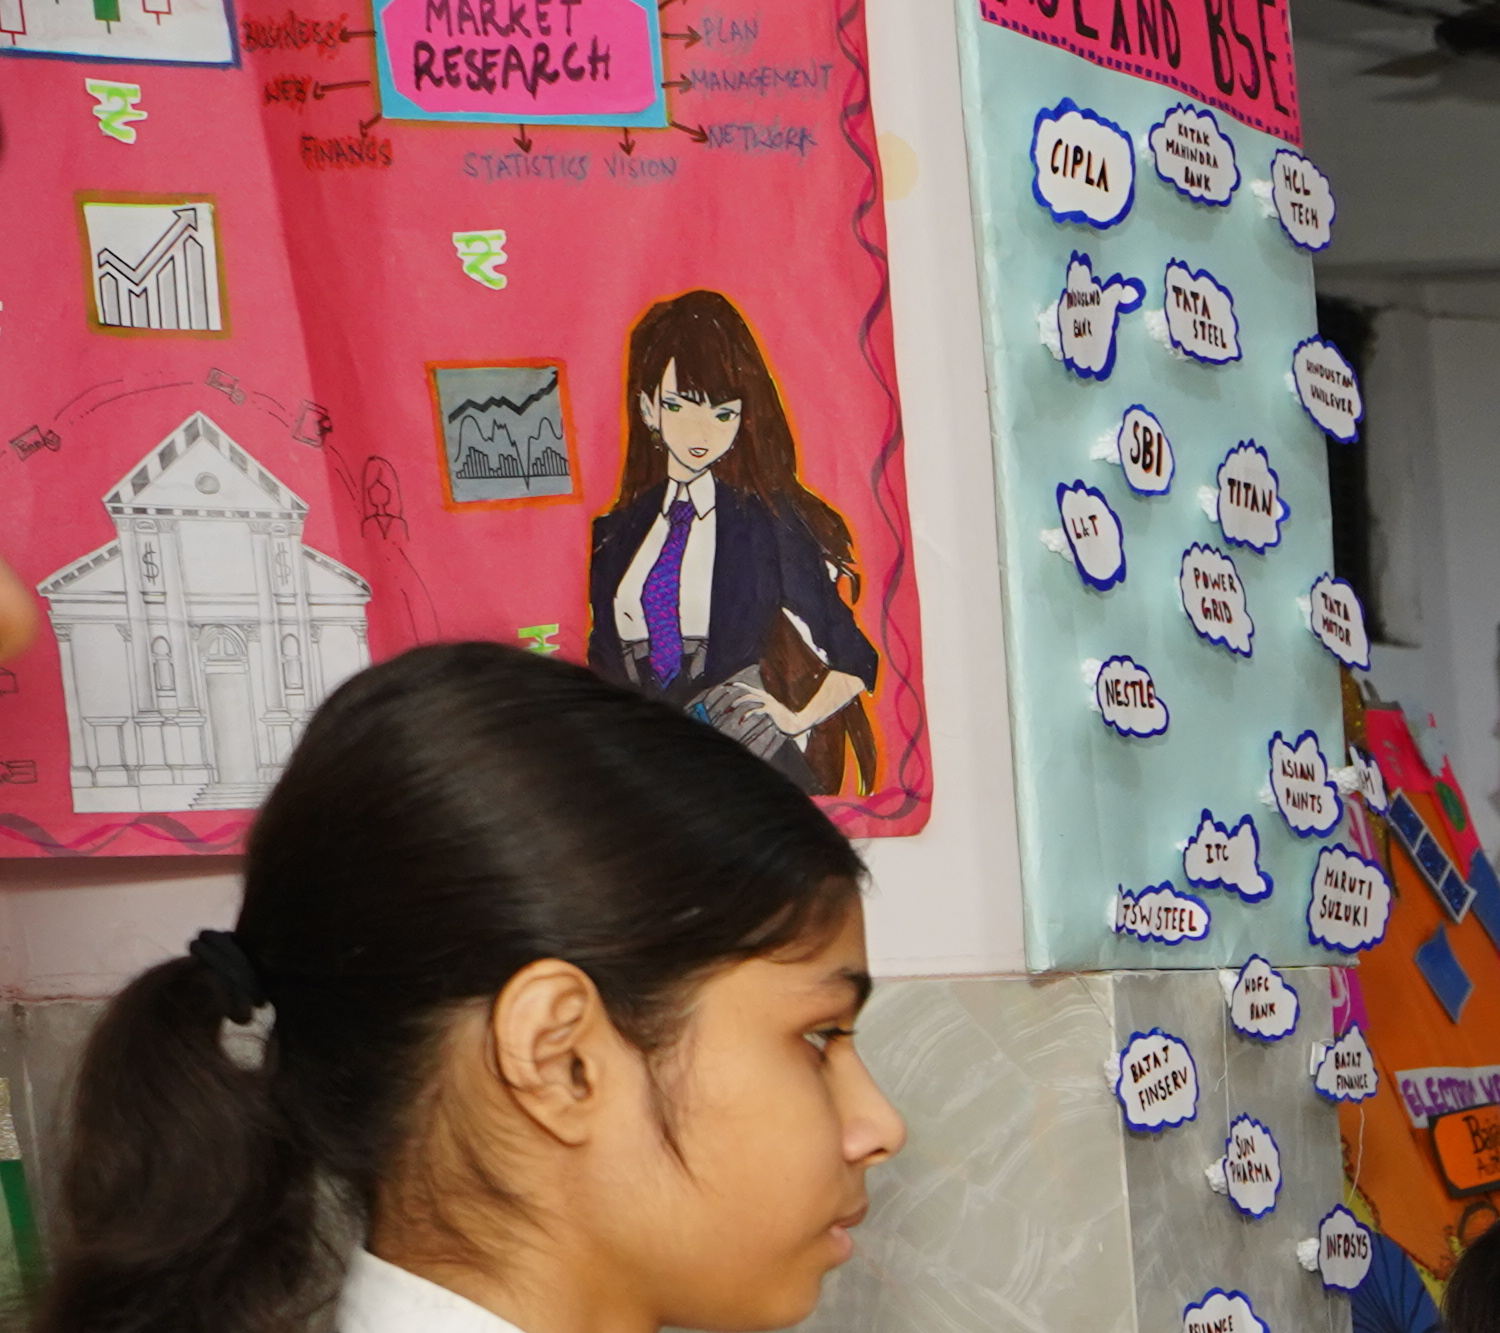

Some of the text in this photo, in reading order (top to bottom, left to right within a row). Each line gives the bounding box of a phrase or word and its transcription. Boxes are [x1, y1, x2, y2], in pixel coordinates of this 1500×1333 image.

[425, 0, 584, 38] MARKET
[412, 35, 611, 99] RESEARCH
[1207, 0, 1290, 117] BSE
[690, 64, 832, 95] MANAGEMENT
[1178, 123, 1210, 147] KOTAK
[463, 153, 589, 180] STATISTICS
[1051, 138, 1109, 192] CIPLA
[1166, 139, 1219, 169] MAHINDRA
[1184, 166, 1211, 192] BANK
[1283, 164, 1310, 196] HCL
[1291, 201, 1319, 230] TECH
[1172, 286, 1210, 319] TATA
[1193, 319, 1227, 349] STEEL
[1306, 358, 1354, 389] HINDUSTAN
[1310, 384, 1353, 415] UNILEVER
[1130, 421, 1163, 477] SBI
[1228, 478, 1273, 517] TITAN
[1194, 566, 1237, 595] POWER
[1201, 597, 1233, 624] GRID
[1321, 592, 1350, 621] TATA
[1322, 617, 1352, 646] MOTOR
[1105, 679, 1155, 710] NESTLE
[1282, 759, 1315, 782] ASIAN
[1285, 791, 1322, 814] PAINTS
[1205, 843, 1229, 863] ITC
[1324, 867, 1373, 899] MARUTI
[1155, 905, 1197, 932] STEEL
[1319, 898, 1368, 927] SUZUKI
[1245, 976, 1270, 993] HDFC
[1250, 1003, 1276, 1020] BANK
[1131, 1045, 1170, 1083] BAJAJ
[1334, 1051, 1362, 1070] BAJAJ
[1138, 1067, 1188, 1111] FINSERV
[1336, 1073, 1368, 1090] FINANCE
[1236, 1135, 1254, 1160] SUN
[1230, 1161, 1273, 1184] PHARMA
[1327, 1233, 1368, 1260] INFOSYS
